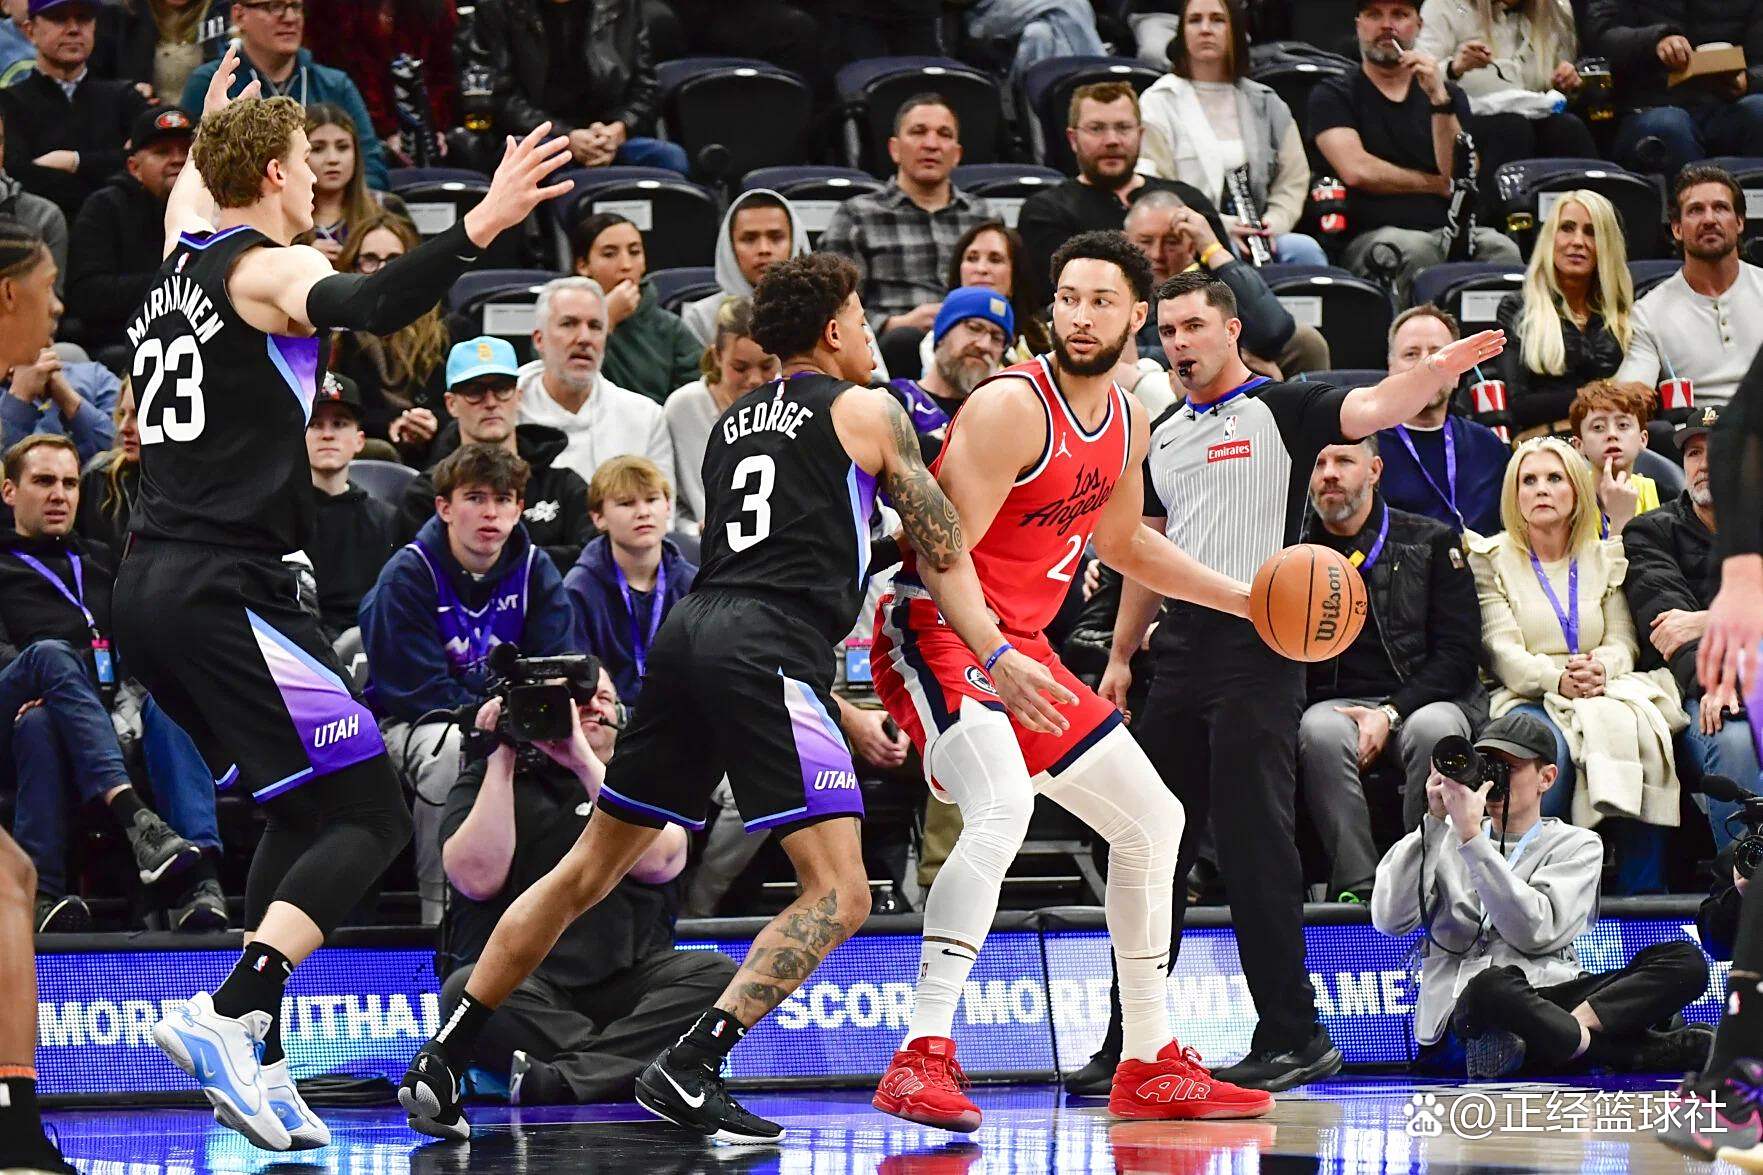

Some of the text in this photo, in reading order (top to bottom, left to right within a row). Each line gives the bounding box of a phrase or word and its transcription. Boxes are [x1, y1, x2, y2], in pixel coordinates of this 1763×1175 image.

[127, 275, 224, 348] MARKKANEN
[132, 335, 205, 445] 23
[723, 400, 813, 444] GEORGE
[1208, 445, 1250, 460] Emirates
[725, 454, 776, 553] 3
[1068, 464, 1101, 502] Los
[1018, 479, 1116, 536] Angele
[1046, 531, 1094, 582] 2
[1314, 566, 1341, 642] Wilson
[314, 713, 359, 748] UTAH
[814, 770, 856, 790] UTAH
[778, 981, 916, 1029] SCOR
[883, 1067, 924, 1098] AIR
[1136, 1074, 1211, 1102] AIR
